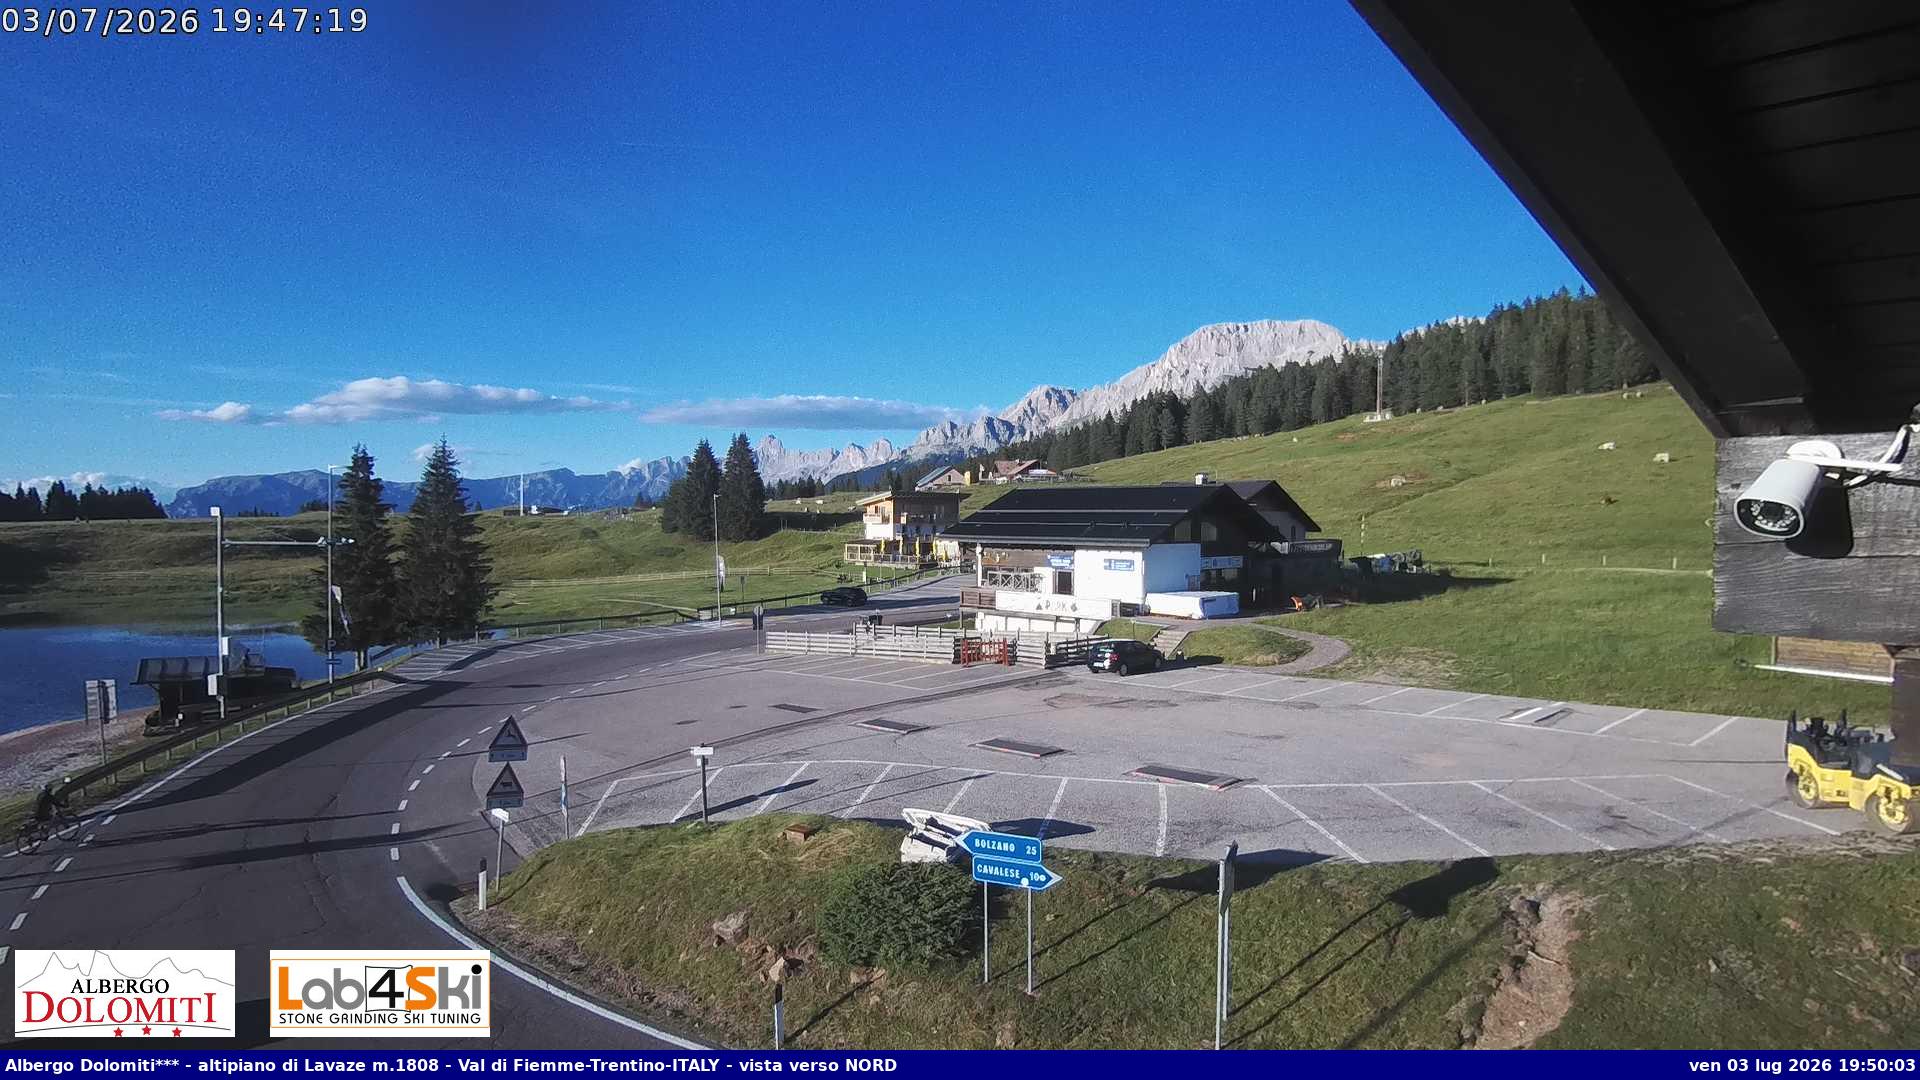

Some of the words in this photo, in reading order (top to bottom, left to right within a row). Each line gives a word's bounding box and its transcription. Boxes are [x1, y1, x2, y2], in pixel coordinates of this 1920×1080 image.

[975, 838, 1015, 852] BOLZANO
[1025, 845, 1037, 855] 25
[976, 864, 1020, 879] CAVALESE
